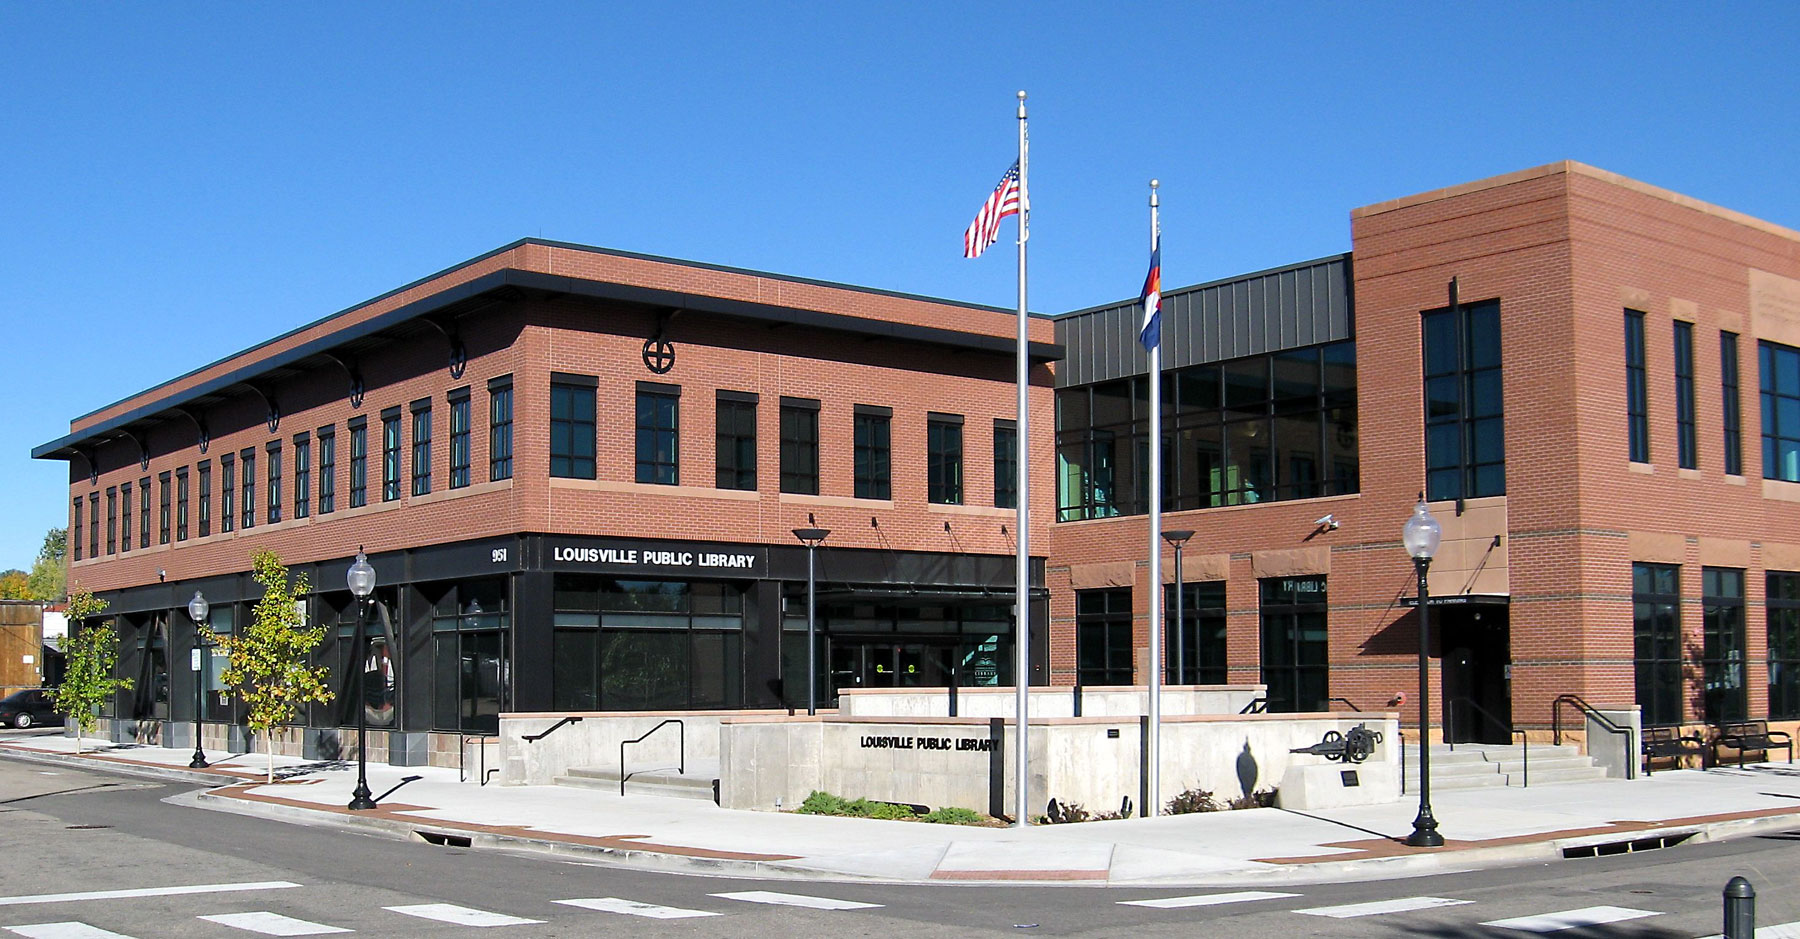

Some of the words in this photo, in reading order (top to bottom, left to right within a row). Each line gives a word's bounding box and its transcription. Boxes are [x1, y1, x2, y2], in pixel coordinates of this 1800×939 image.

[492, 548, 507, 562] 951
[554, 547, 637, 564] LOUISVILLE
[643, 550, 693, 566] PUBLIC
[698, 552, 755, 569] LIBRARY
[860, 736, 913, 749] LOUISVILLE
[917, 737, 951, 750] PUBLIC
[955, 738, 999, 752] LIBRARY
